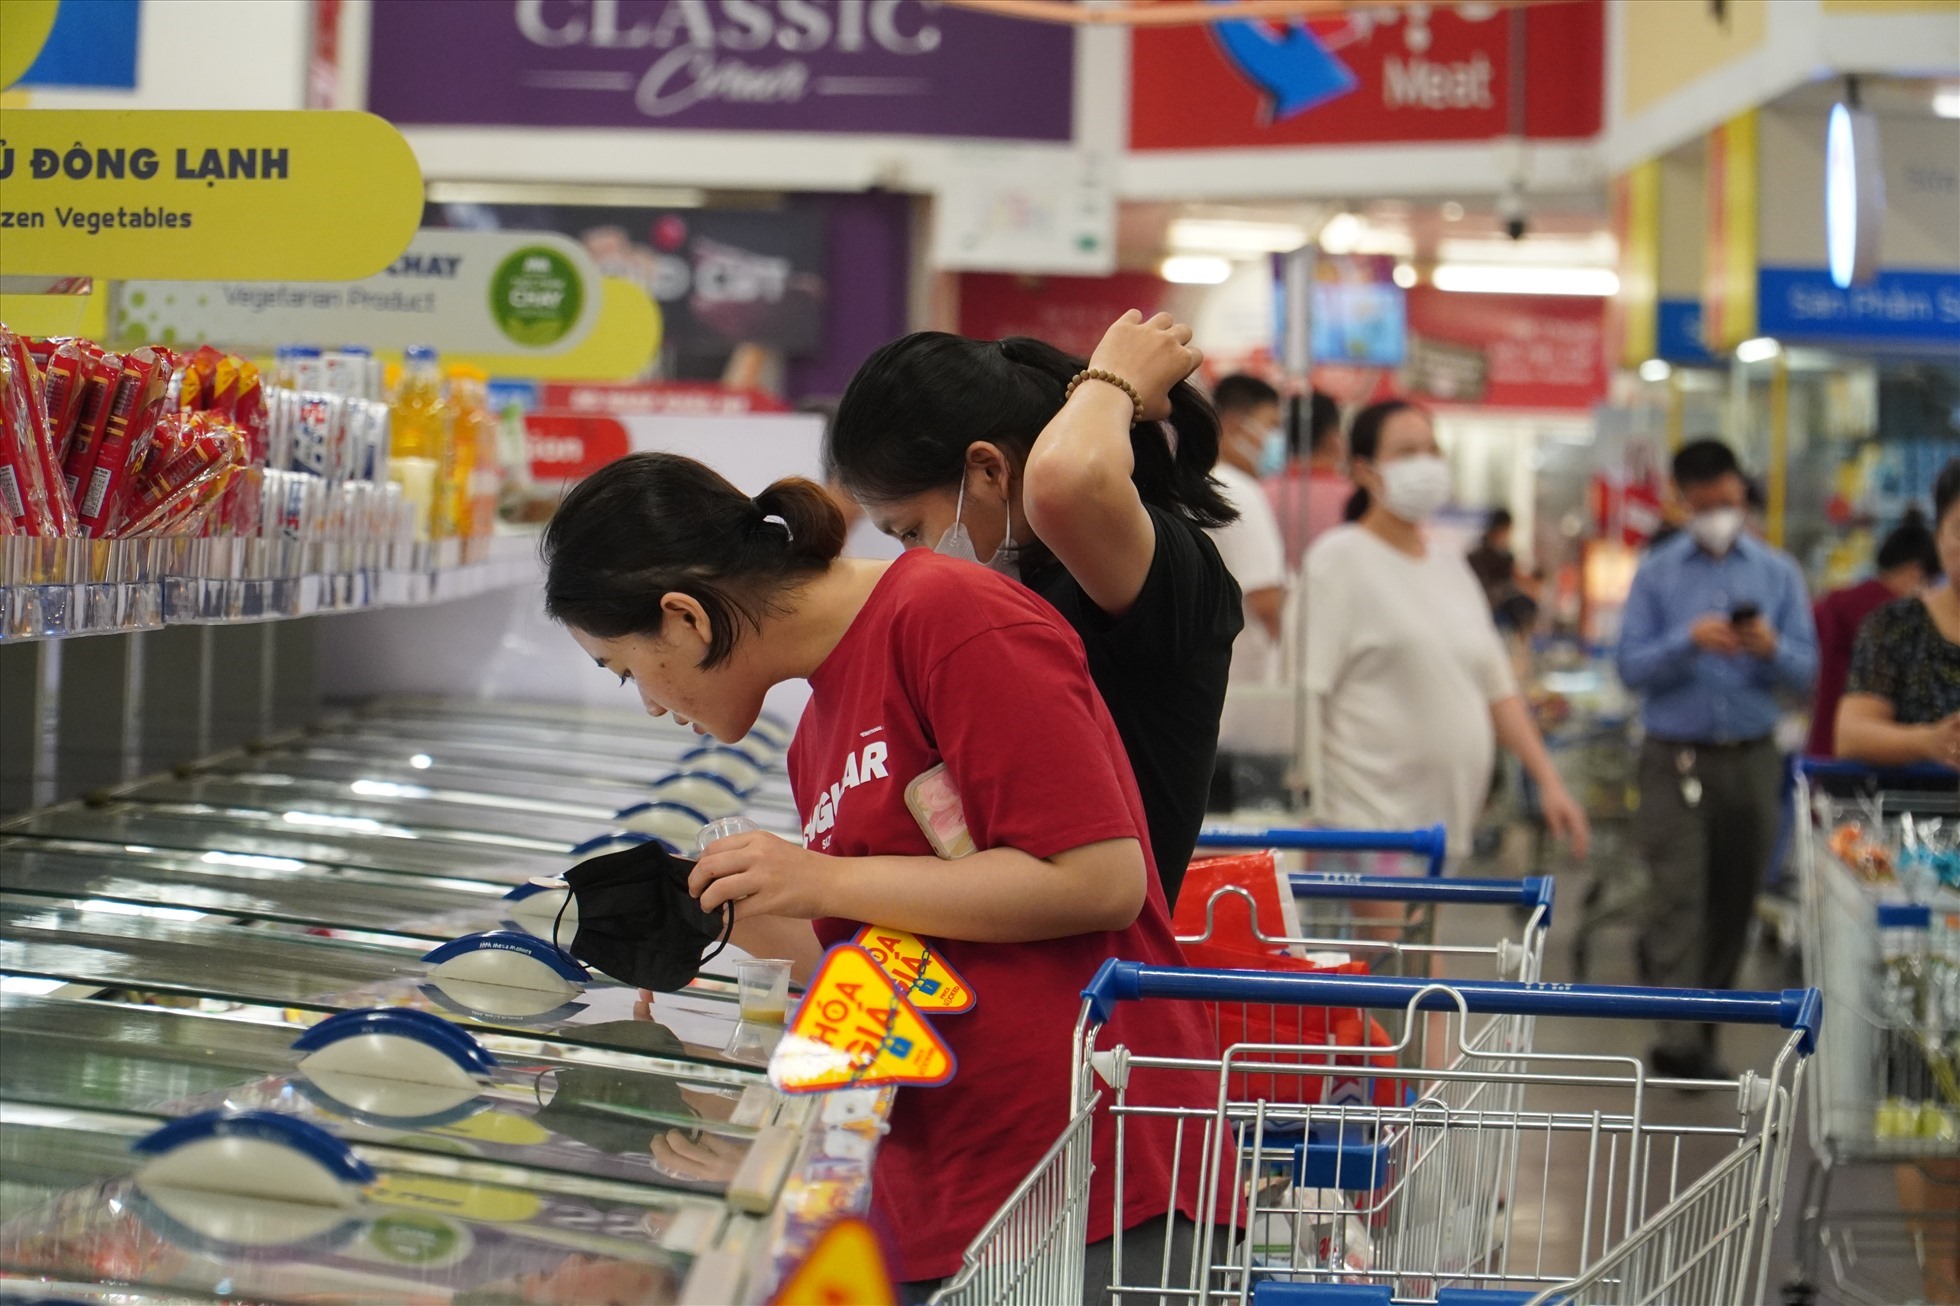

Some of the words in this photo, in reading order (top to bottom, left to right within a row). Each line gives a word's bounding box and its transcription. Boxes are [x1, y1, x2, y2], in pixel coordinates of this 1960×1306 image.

[515, 0, 942, 54] CLASSIC
[1383, 52, 1494, 109] Meat
[30, 141, 160, 180] ĐÔNG
[175, 148, 289, 188] LẠNH
[55, 207, 192, 235] Vegetables
[222, 285, 342, 312] Vegetarian
[347, 287, 436, 313] Product
